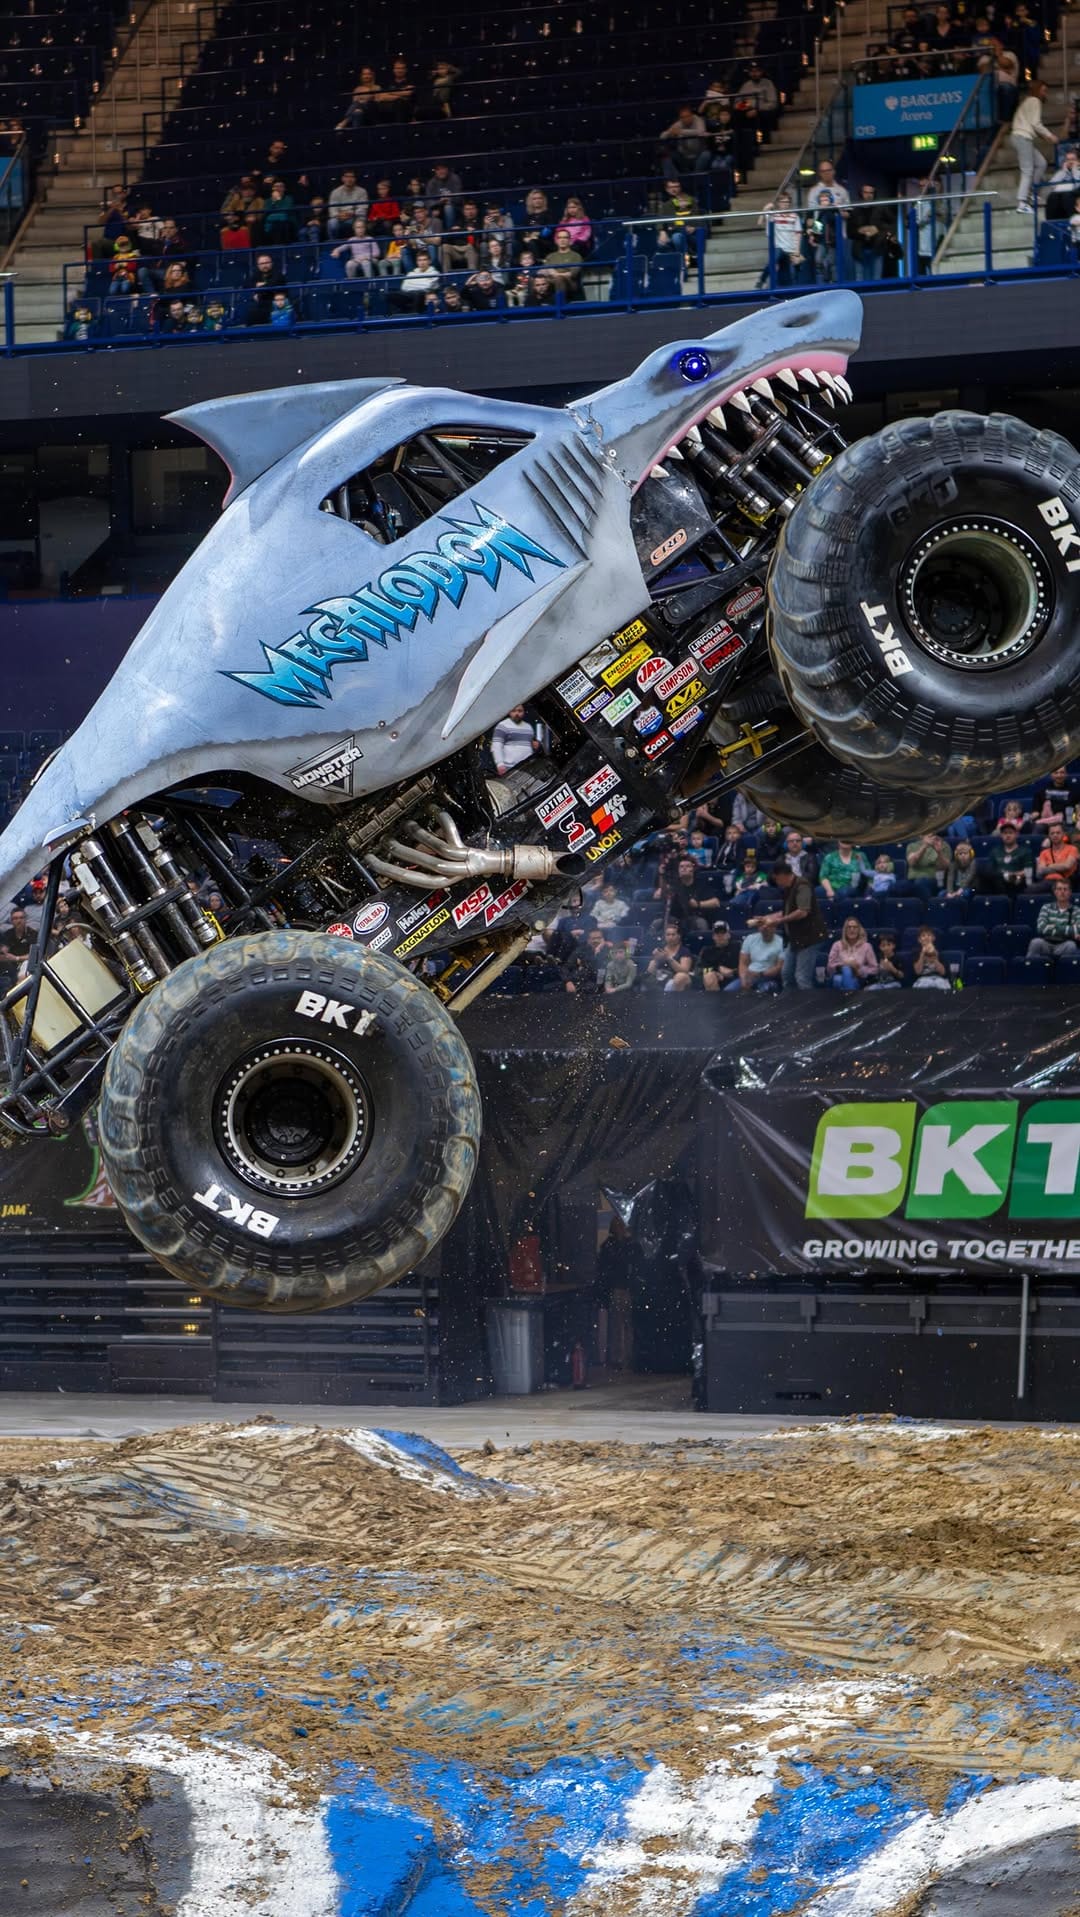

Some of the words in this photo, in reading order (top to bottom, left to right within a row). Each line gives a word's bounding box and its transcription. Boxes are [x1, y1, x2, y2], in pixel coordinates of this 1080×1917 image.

[900, 90, 962, 108] BARCLAYS
[901, 111, 933, 122] Arena
[218, 498, 568, 709] MEGALODON
[623, 624, 639, 641] Auto
[691, 625, 722, 652] LINCOLN
[860, 601, 913, 677] BKT
[606, 654, 633, 679] ENERGY
[638, 659, 666, 684] JAZ
[659, 662, 694, 696] SIMPSON
[606, 691, 634, 720] BKT
[644, 734, 668, 755] Coan
[293, 745, 363, 789] MONSTER
[318, 766, 350, 788] JAM
[591, 779, 618, 803] ENDS
[593, 775, 615, 795] ROD
[540, 788, 570, 817] OPTIMA
[586, 829, 621, 860] UNOH
[454, 885, 489, 922] MSD
[485, 879, 528, 922] ARP
[358, 914, 372, 929] TOTAL
[370, 906, 385, 919] SEAL
[399, 903, 431, 930] Holley
[371, 928, 390, 949] KING
[395, 910, 448, 957] MAGNAFLOW
[817, 1123, 1080, 1196] BKT
[192, 1183, 280, 1239] BKT
[802, 1239, 938, 1259] GROWING
